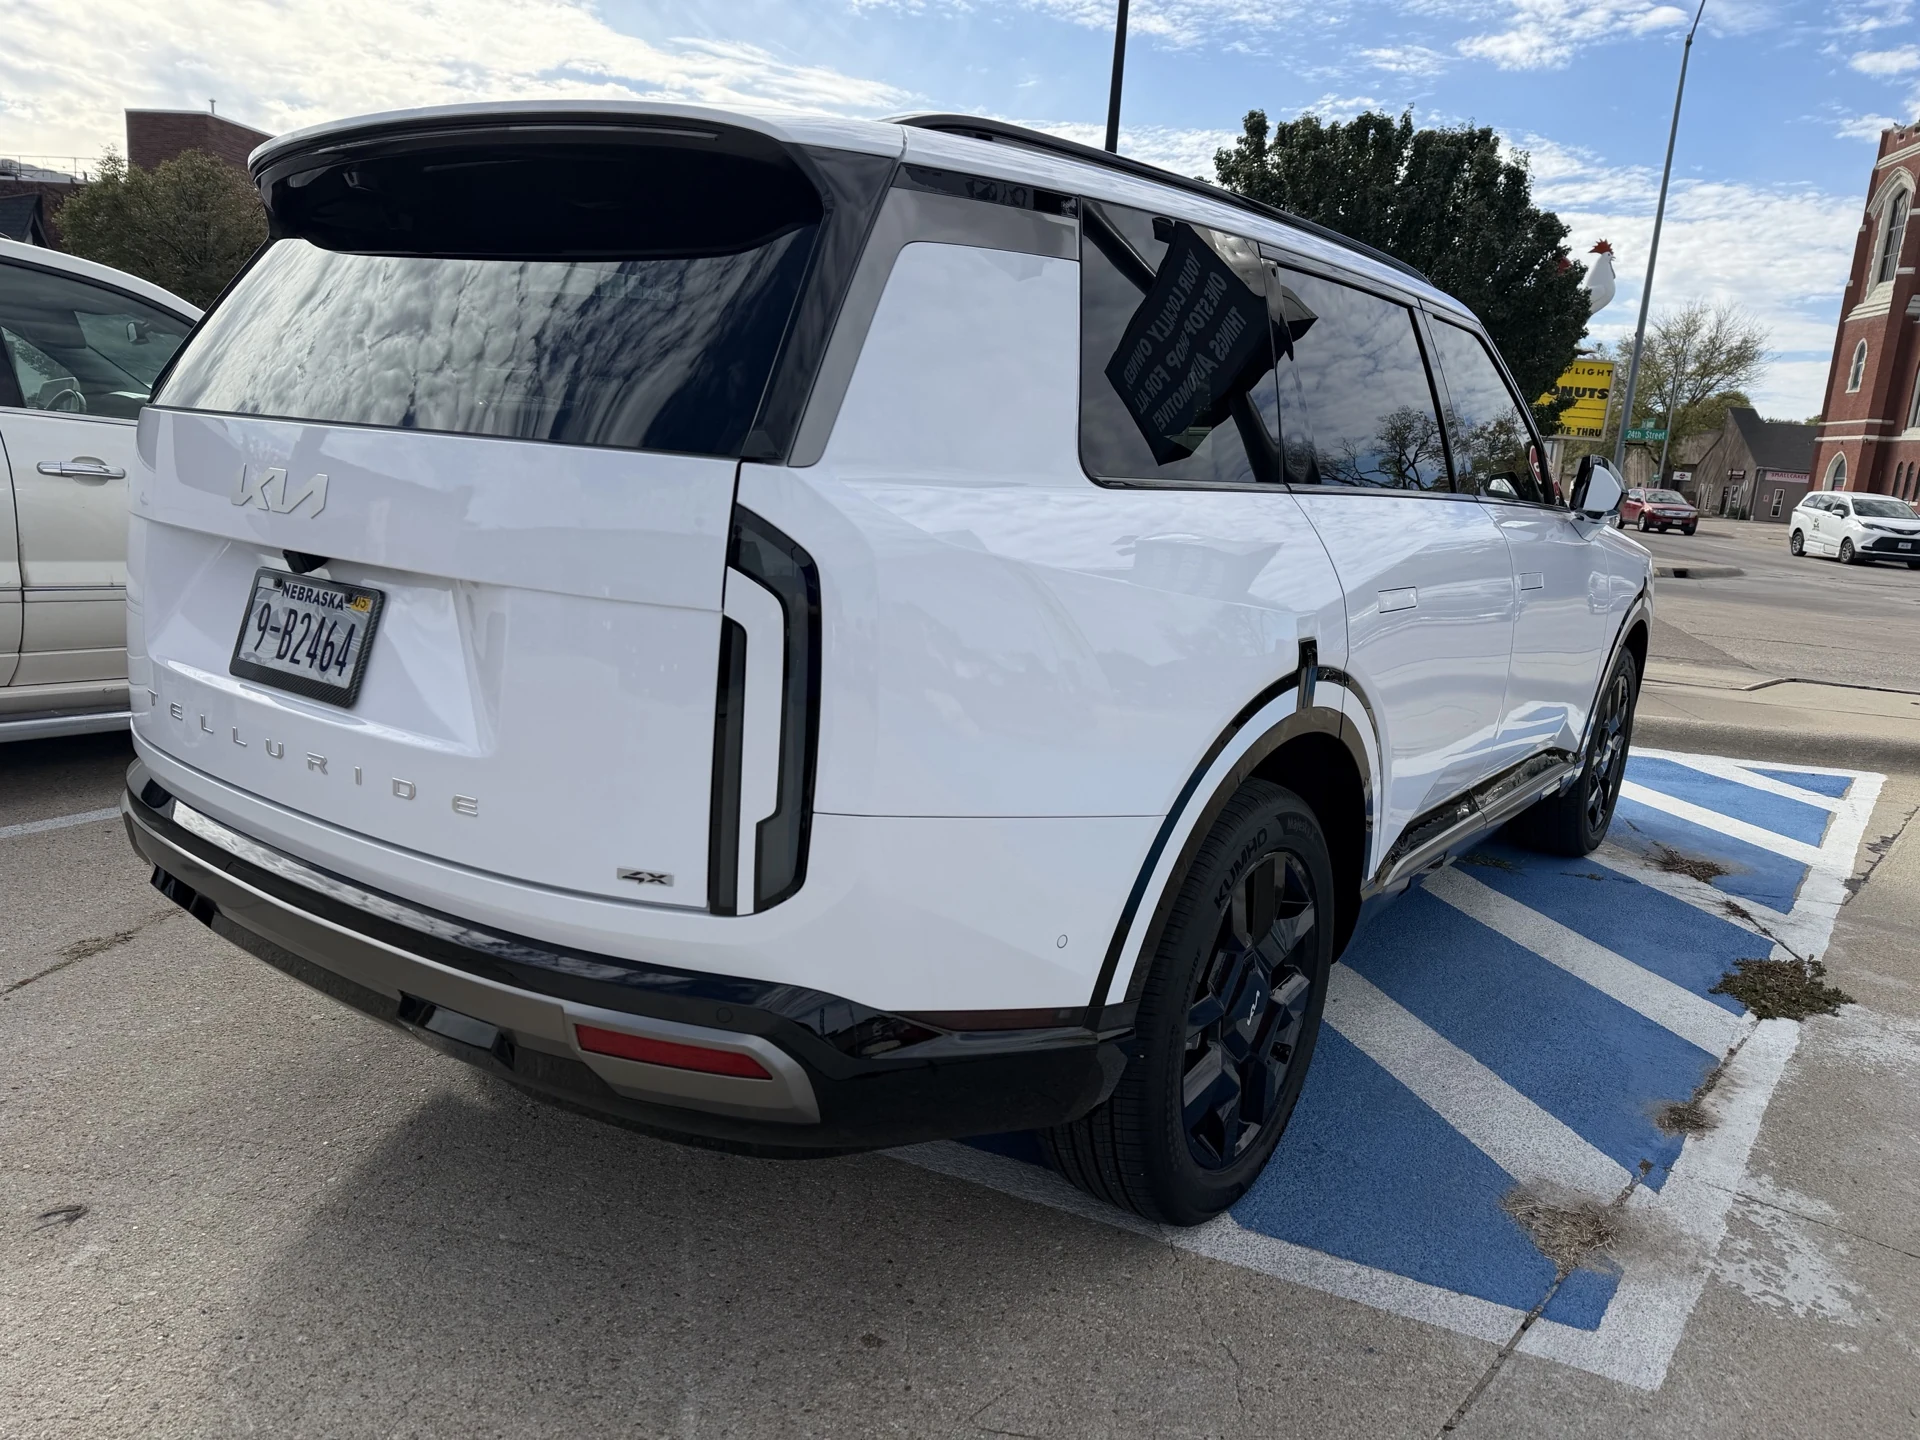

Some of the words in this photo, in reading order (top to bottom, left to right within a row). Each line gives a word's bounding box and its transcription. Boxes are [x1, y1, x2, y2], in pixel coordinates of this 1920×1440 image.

[1547, 385, 1609, 399] ONUTS
[1564, 367, 1613, 377] YLIGHT
[1626, 430, 1641, 439] 24th
[1645, 430, 1665, 440] Street
[229, 462, 330, 520] KIA
[282, 583, 344, 611] NEBRASKA
[254, 602, 356, 677] 9-B2464
[147, 688, 479, 817] TELLURIDE
[1213, 827, 1267, 909] KUMHO
[1181, 946, 1202, 1015] OUTSIDE
